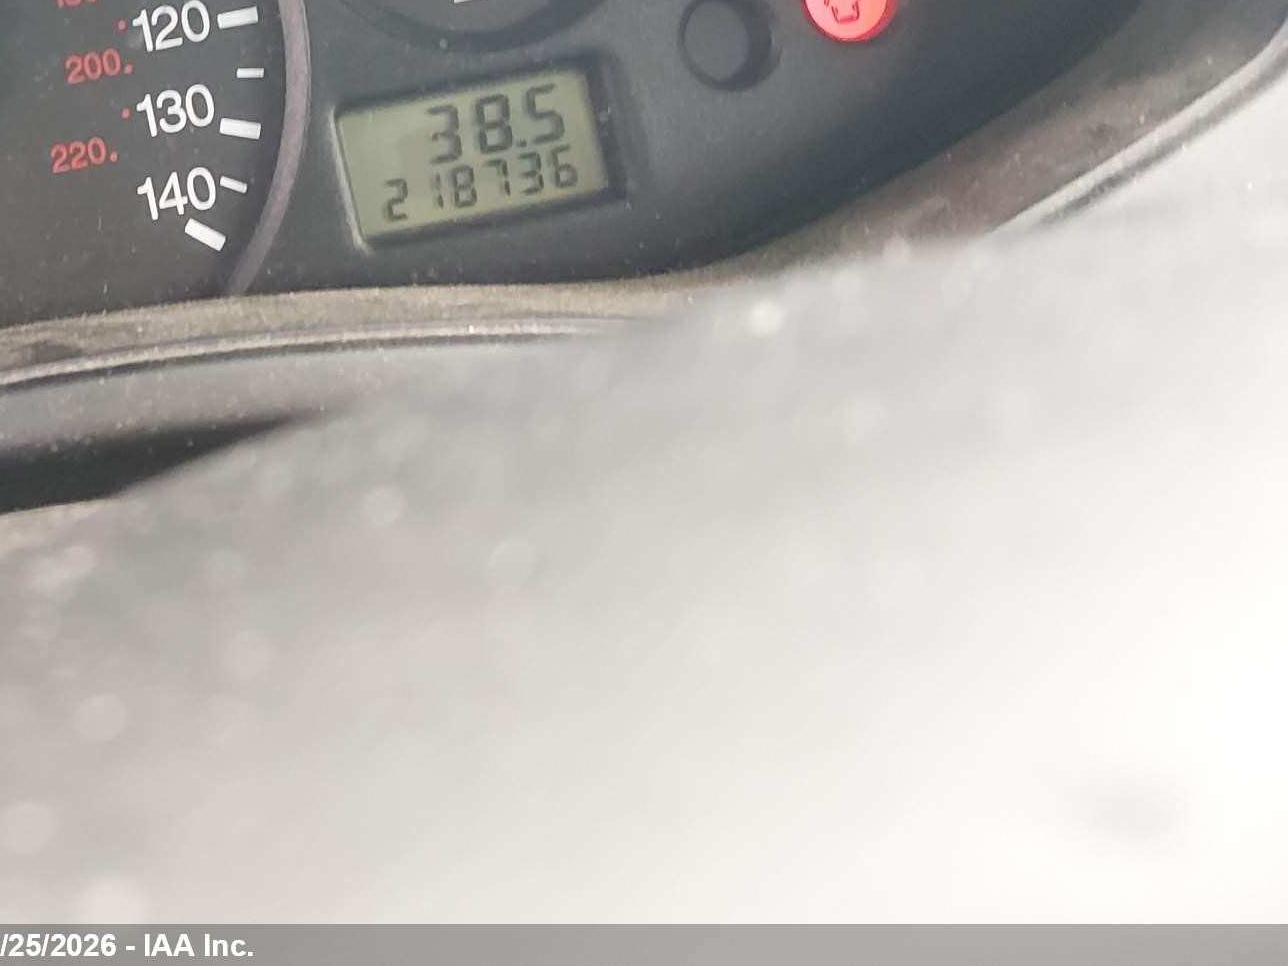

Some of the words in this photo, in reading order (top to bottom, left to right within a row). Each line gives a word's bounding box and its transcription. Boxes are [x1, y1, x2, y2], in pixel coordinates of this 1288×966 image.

[132, 0, 210, 52] 120
[65, 48, 122, 84] 200
[136, 84, 215, 138] 130
[427, 83, 565, 165] 38.5
[50, 137, 107, 174] 220
[136, 167, 217, 221] 140
